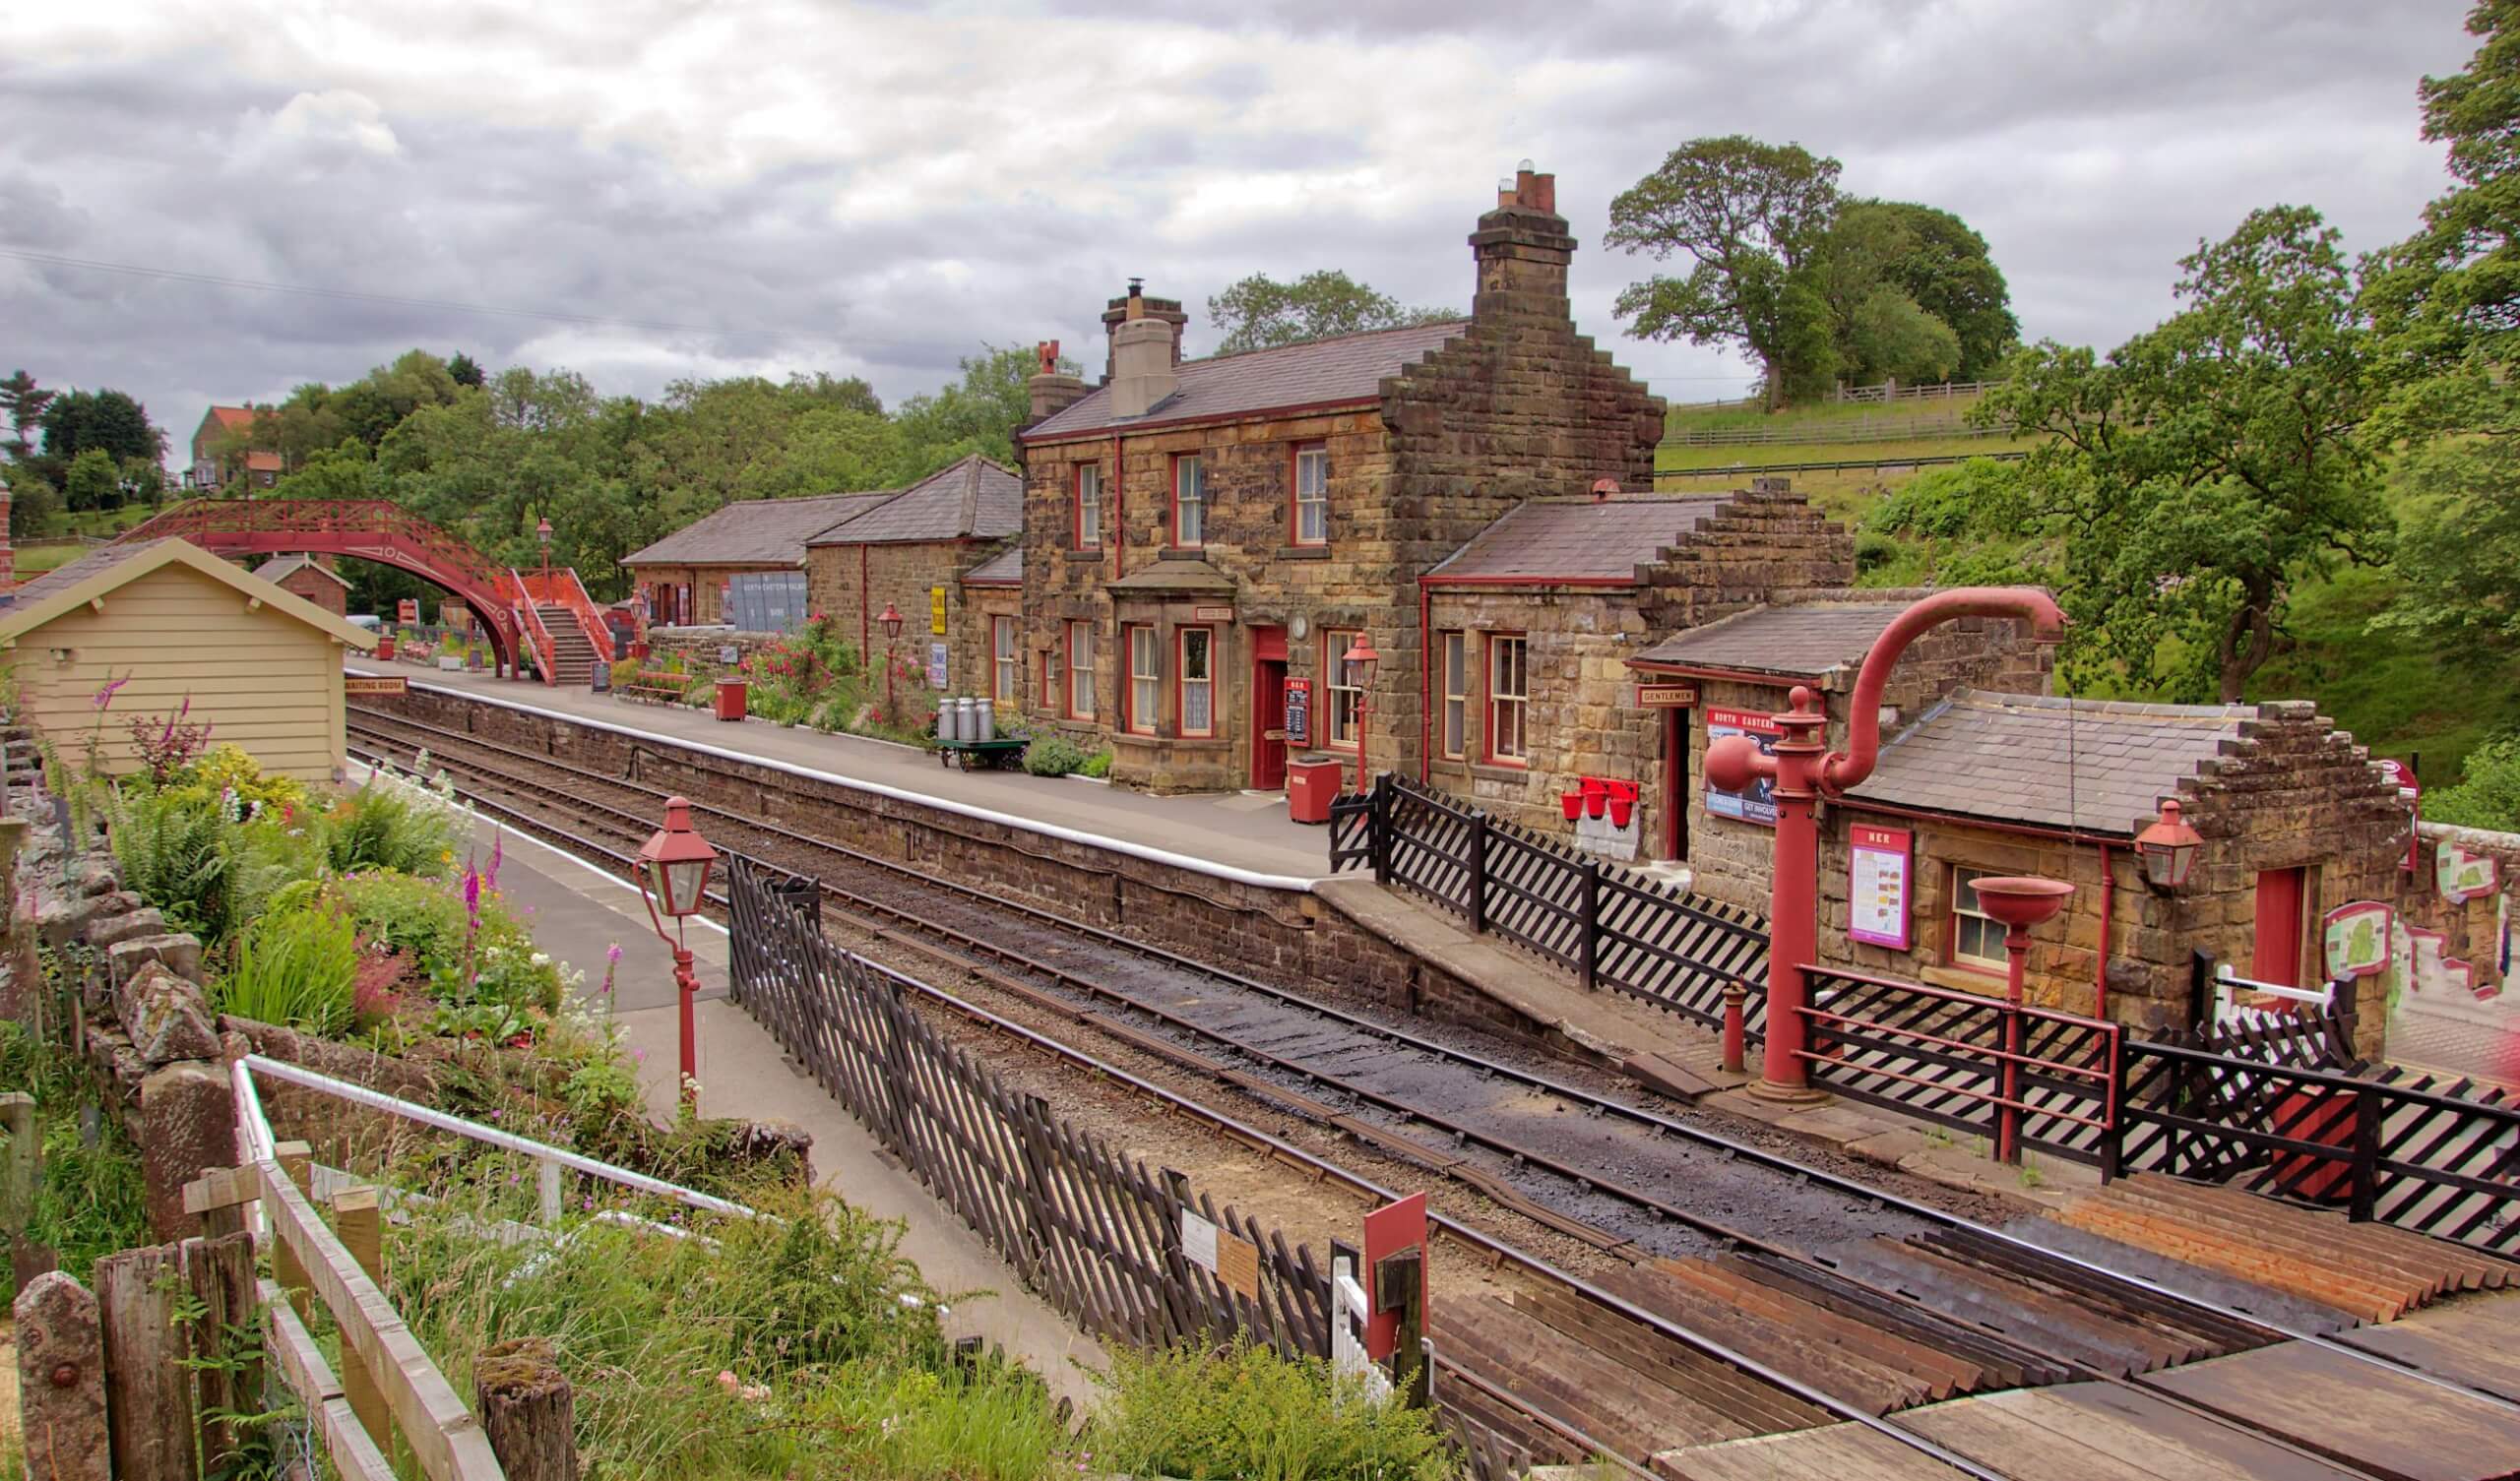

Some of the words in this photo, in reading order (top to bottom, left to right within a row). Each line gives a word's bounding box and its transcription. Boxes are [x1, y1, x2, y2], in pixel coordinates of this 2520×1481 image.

[378, 681, 402, 690] ROOM
[1644, 692, 1692, 702] GENTLEMEN
[1715, 711, 1736, 723] NORTH
[1868, 832, 1890, 843] NER
